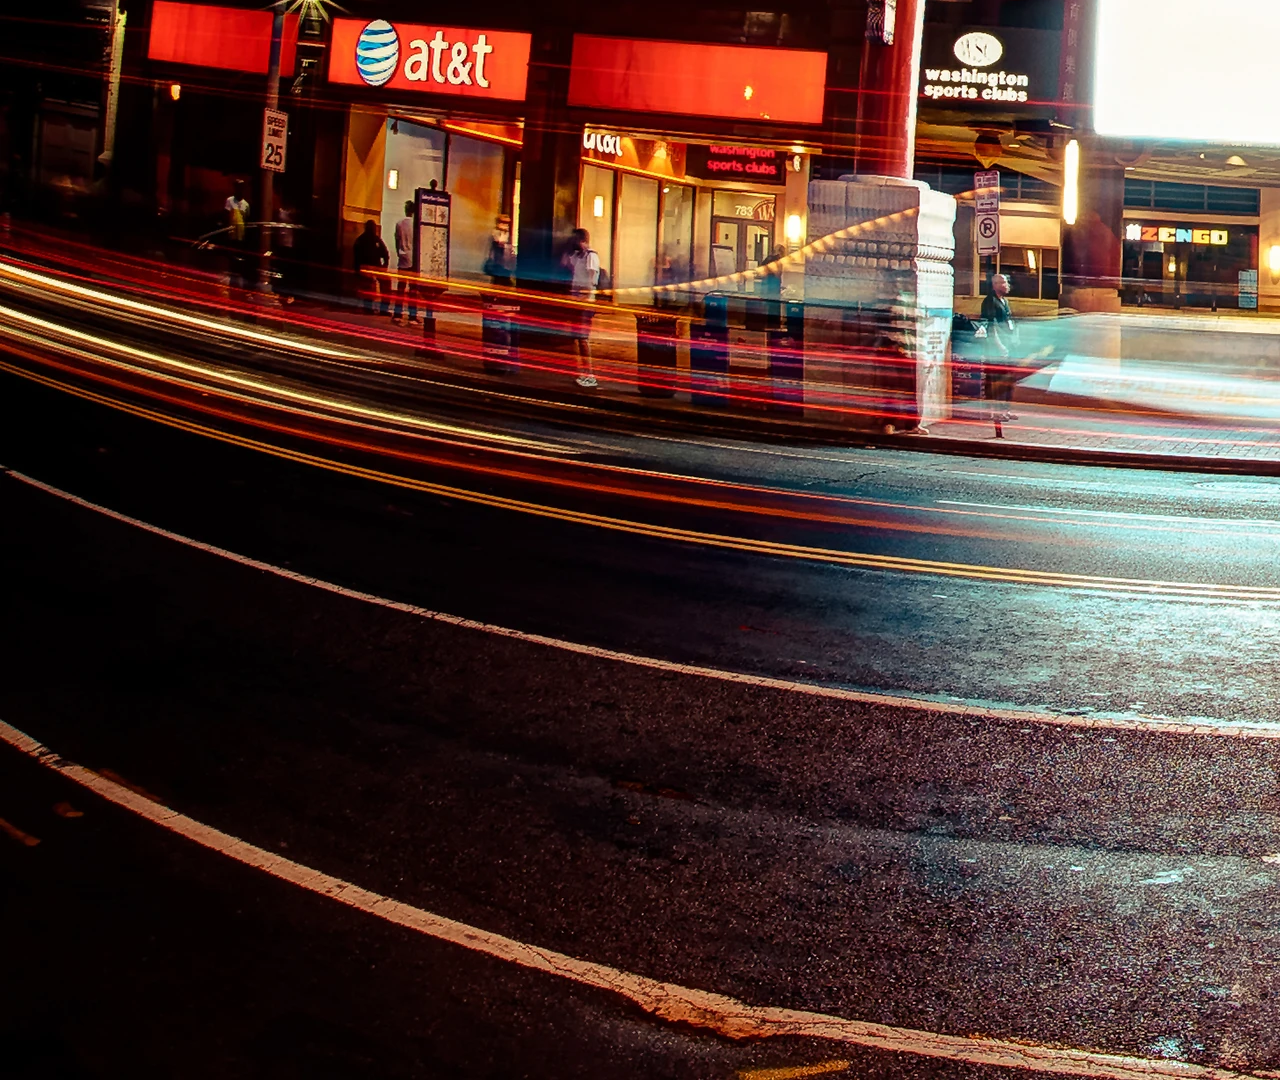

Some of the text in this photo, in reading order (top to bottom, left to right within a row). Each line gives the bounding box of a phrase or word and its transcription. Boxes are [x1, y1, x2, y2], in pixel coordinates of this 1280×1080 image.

[404, 30, 493, 88] at&t
[924, 68, 1029, 87] washington
[924, 84, 1028, 102] sports clubs
[265, 142, 284, 166] 25
[707, 159, 777, 175] sports clubs
[735, 205, 754, 217] 783
